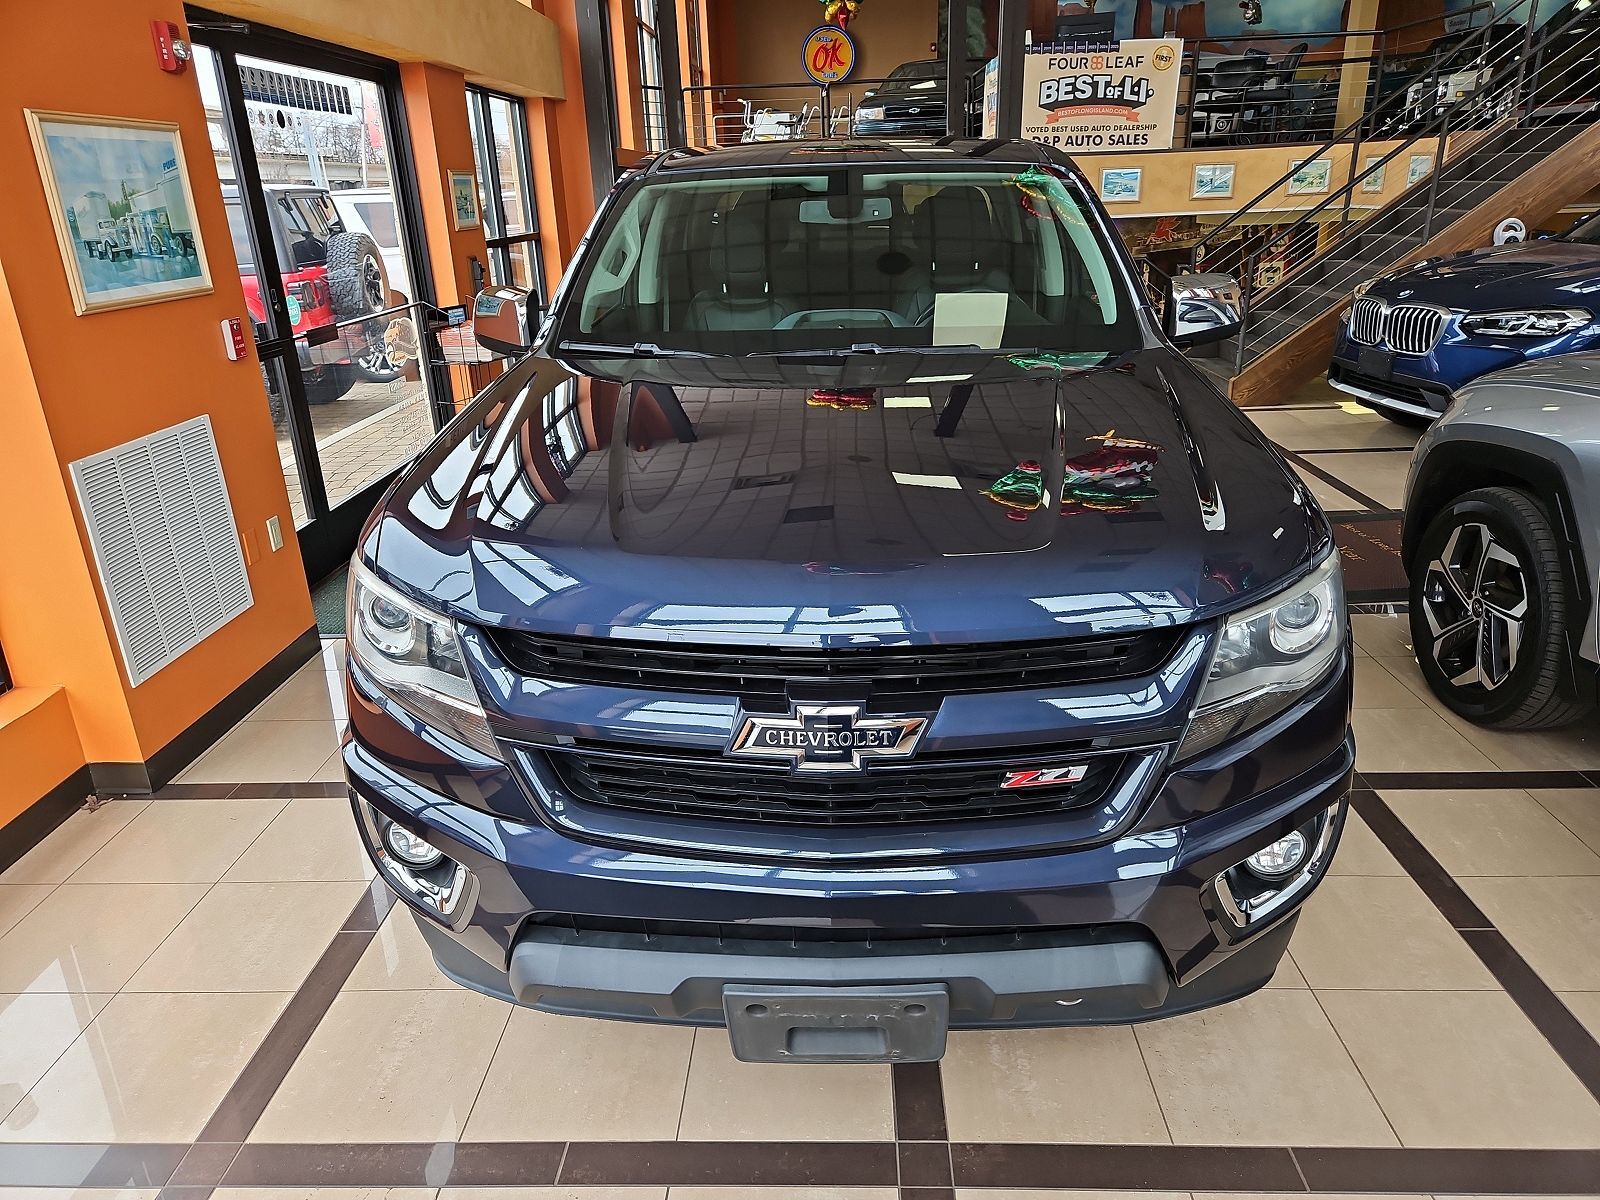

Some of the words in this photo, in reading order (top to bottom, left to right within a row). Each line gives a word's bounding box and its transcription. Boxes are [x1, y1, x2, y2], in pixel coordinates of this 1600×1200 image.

[160, 36, 168, 60] FIRE
[813, 38, 845, 72] OK
[1048, 57, 1089, 70] FOUR
[1105, 55, 1145, 69] LEAF
[1155, 54, 1173, 63] FIRST
[1040, 75, 1112, 104] BEST
[1105, 86, 1123, 99] OF
[1057, 108, 1128, 117] BESTOFLONGISLAND.COM
[1025, 126, 1050, 134] VOTED
[1051, 125, 1069, 133] BEST
[1070, 125, 1090, 133] USED
[1091, 124, 1112, 132] AUTO
[1113, 123, 1158, 132] DEALERSHIP
[1064, 134, 1104, 147] AUTO
[1108, 133, 1149, 146] SALES
[163, 158, 176, 171] PURE
[765, 730, 893, 748] CHEVROLET
[1000, 765, 1089, 788] Z71
